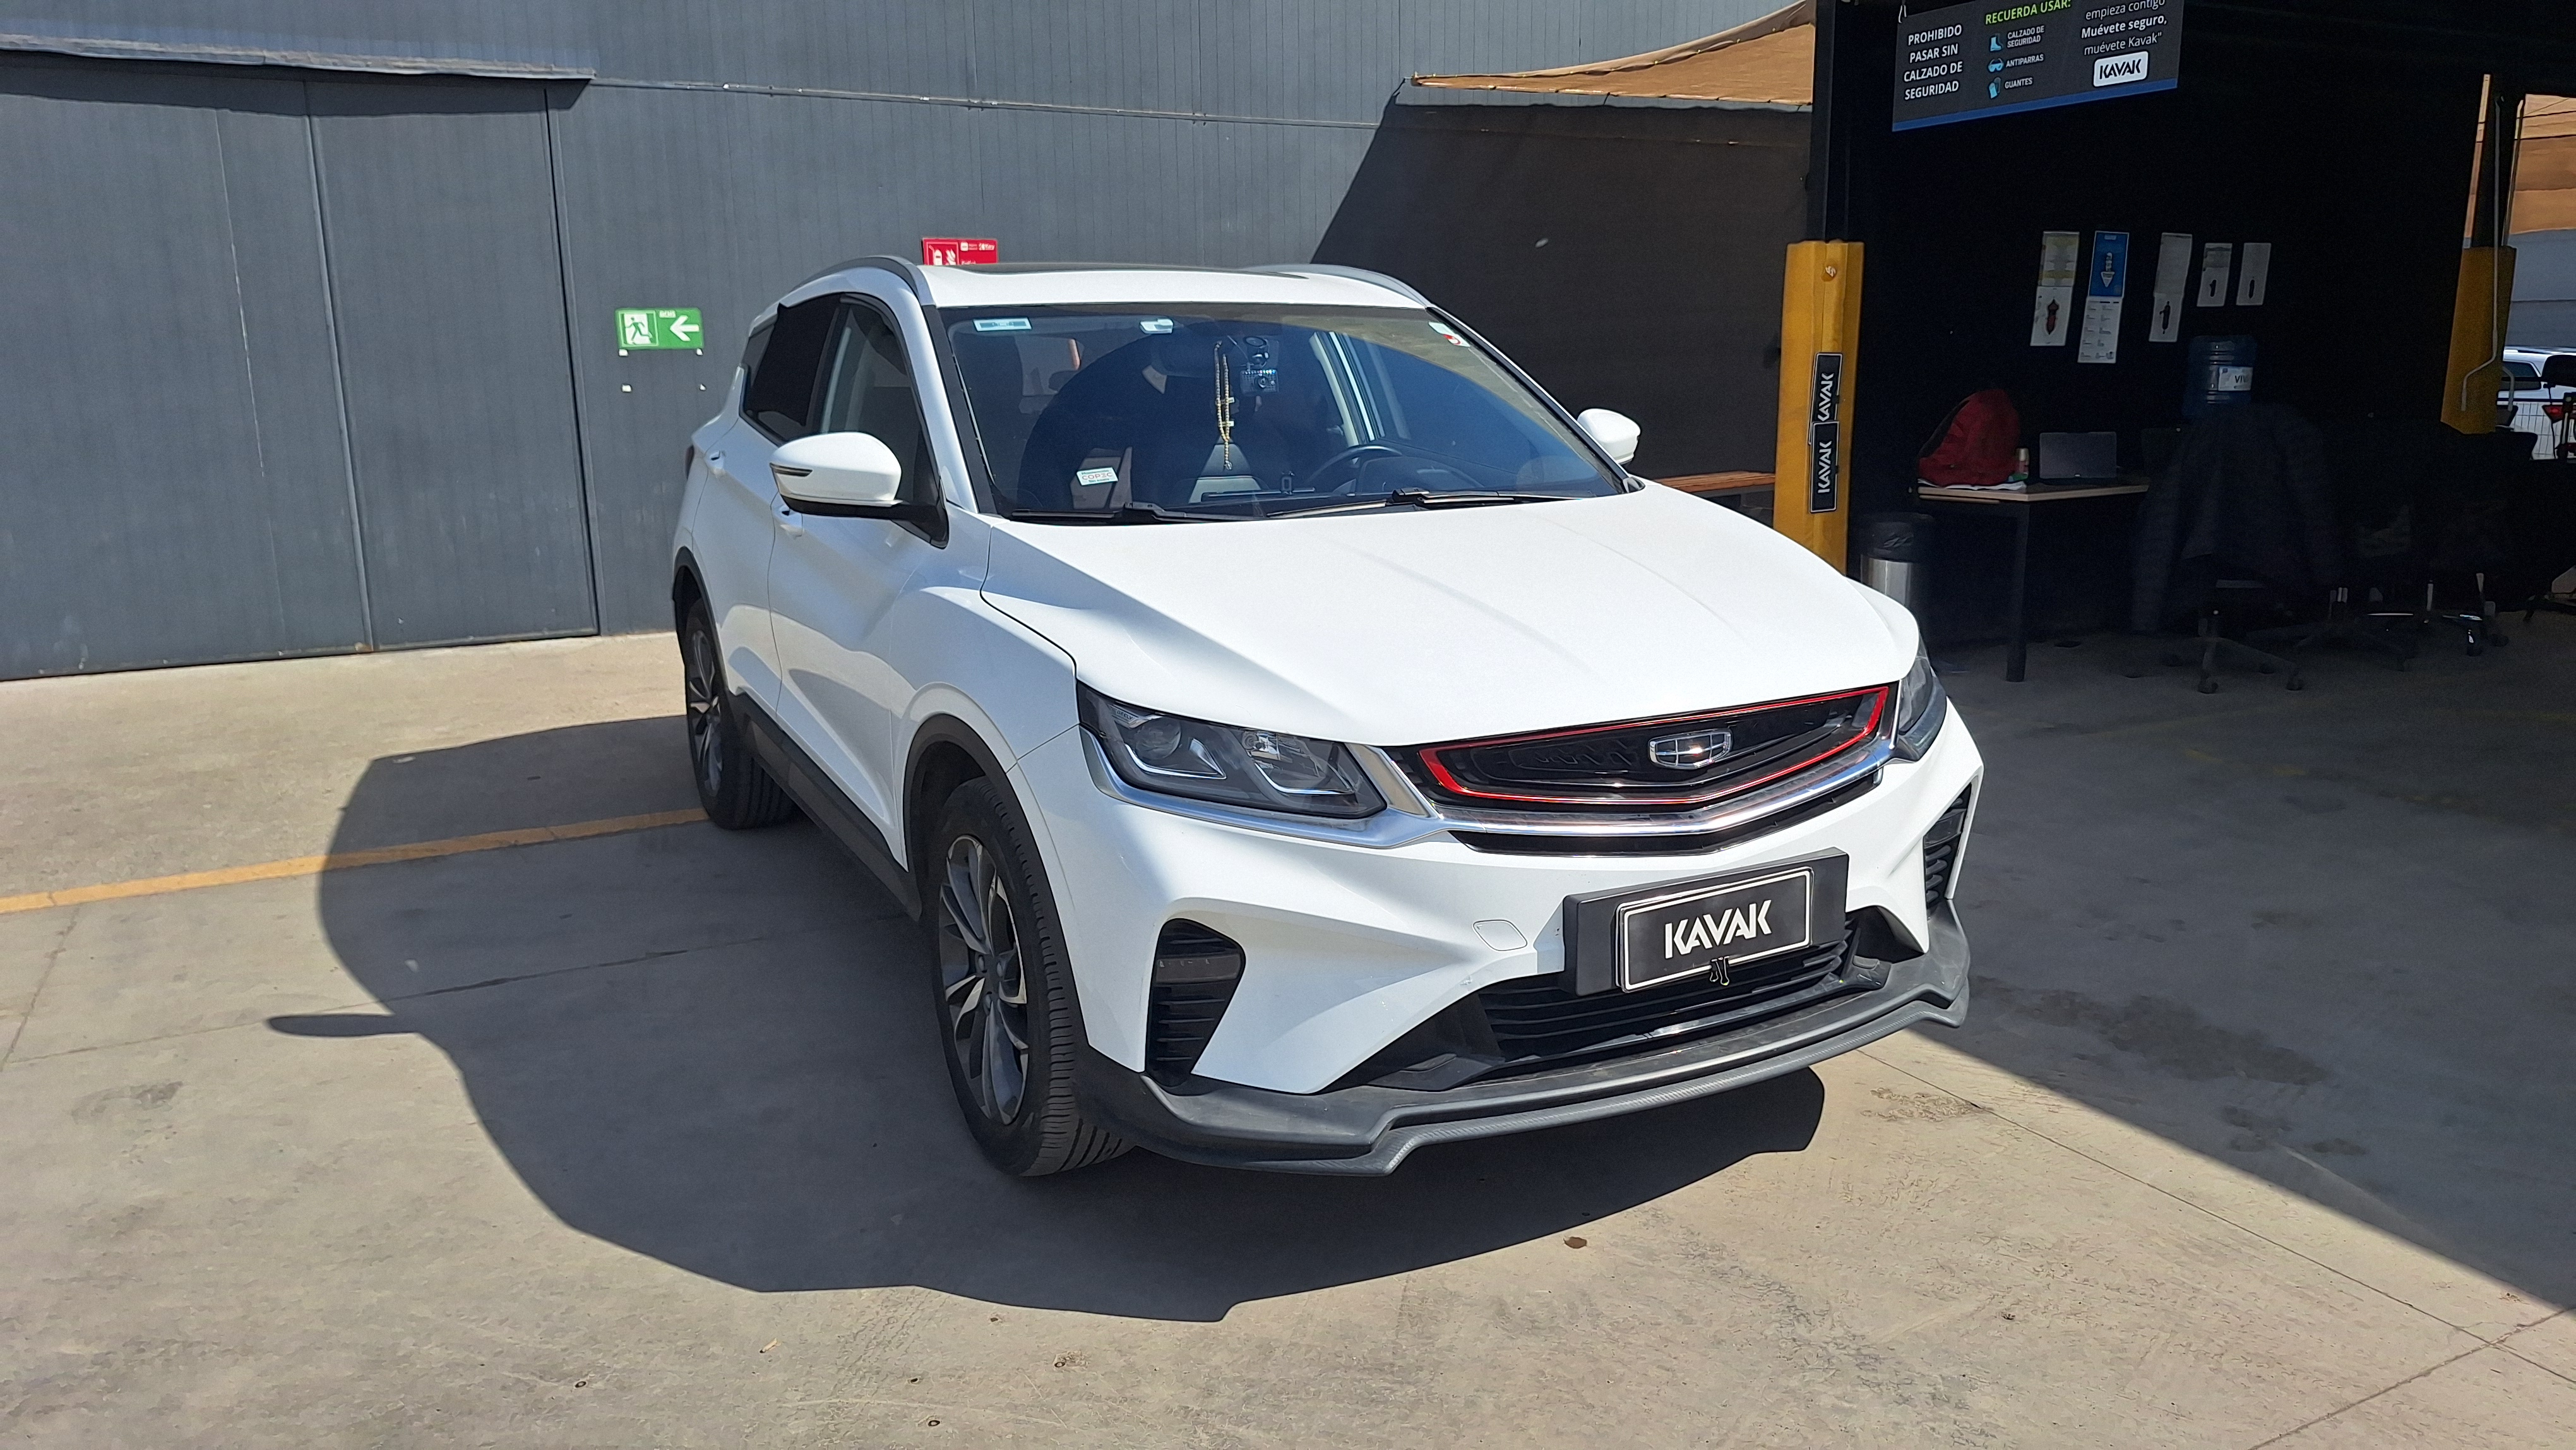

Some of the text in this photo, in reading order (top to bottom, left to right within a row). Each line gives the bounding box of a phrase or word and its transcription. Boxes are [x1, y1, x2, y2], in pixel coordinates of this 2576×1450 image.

[1985, 0, 2072, 25] RECUERDA USAR:
[2085, 4, 2126, 20] empieza
[1908, 24, 1962, 46] PROHIBIDO
[2007, 25, 2045, 39] CALZADO DE
[2081, 15, 2168, 39] Muévete seguro,
[2007, 35, 2041, 49] SEGURIDAD
[2084, 40, 2126, 56] muévete
[1909, 43, 1959, 63] PASAR SIN
[2005, 54, 2044, 68] ANTIPARRAS
[1904, 61, 1963, 82] CALZADO DE
[2099, 58, 2142, 80] KAVAK
[1904, 80, 1959, 100] SEGURIDAD
[2004, 77, 2033, 89] GUANTES
[1816, 440, 1832, 493] KAVAK
[1665, 899, 1772, 959] KAVAK
